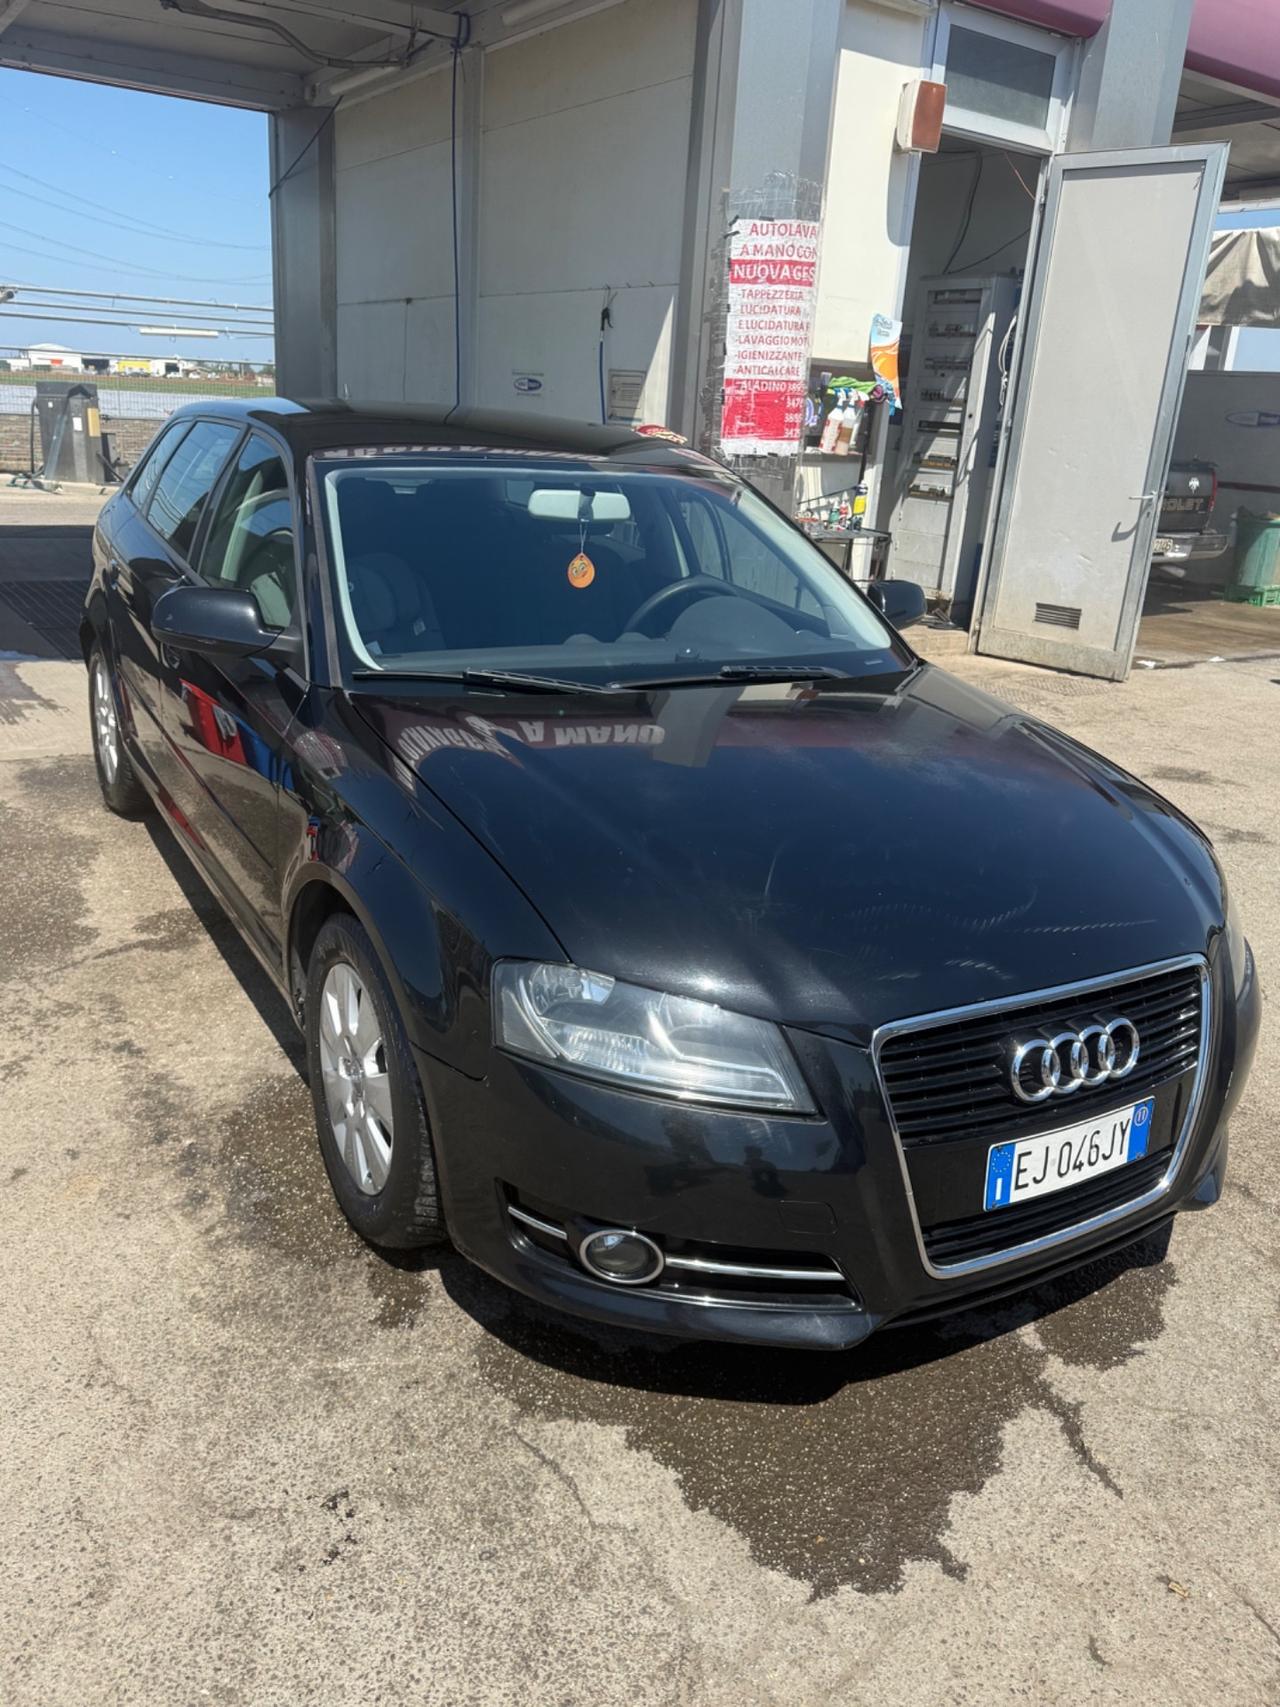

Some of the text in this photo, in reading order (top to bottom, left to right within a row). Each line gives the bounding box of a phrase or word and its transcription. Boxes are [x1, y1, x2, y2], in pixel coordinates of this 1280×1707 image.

[749, 223, 817, 238] AUTOLAVA
[740, 244, 750, 257] A
[753, 244, 795, 257] MANO
[733, 264, 791, 280] NUOVA
[746, 320, 804, 332] LUCIDATURA
[1014, 1145, 1050, 1191] EJ
